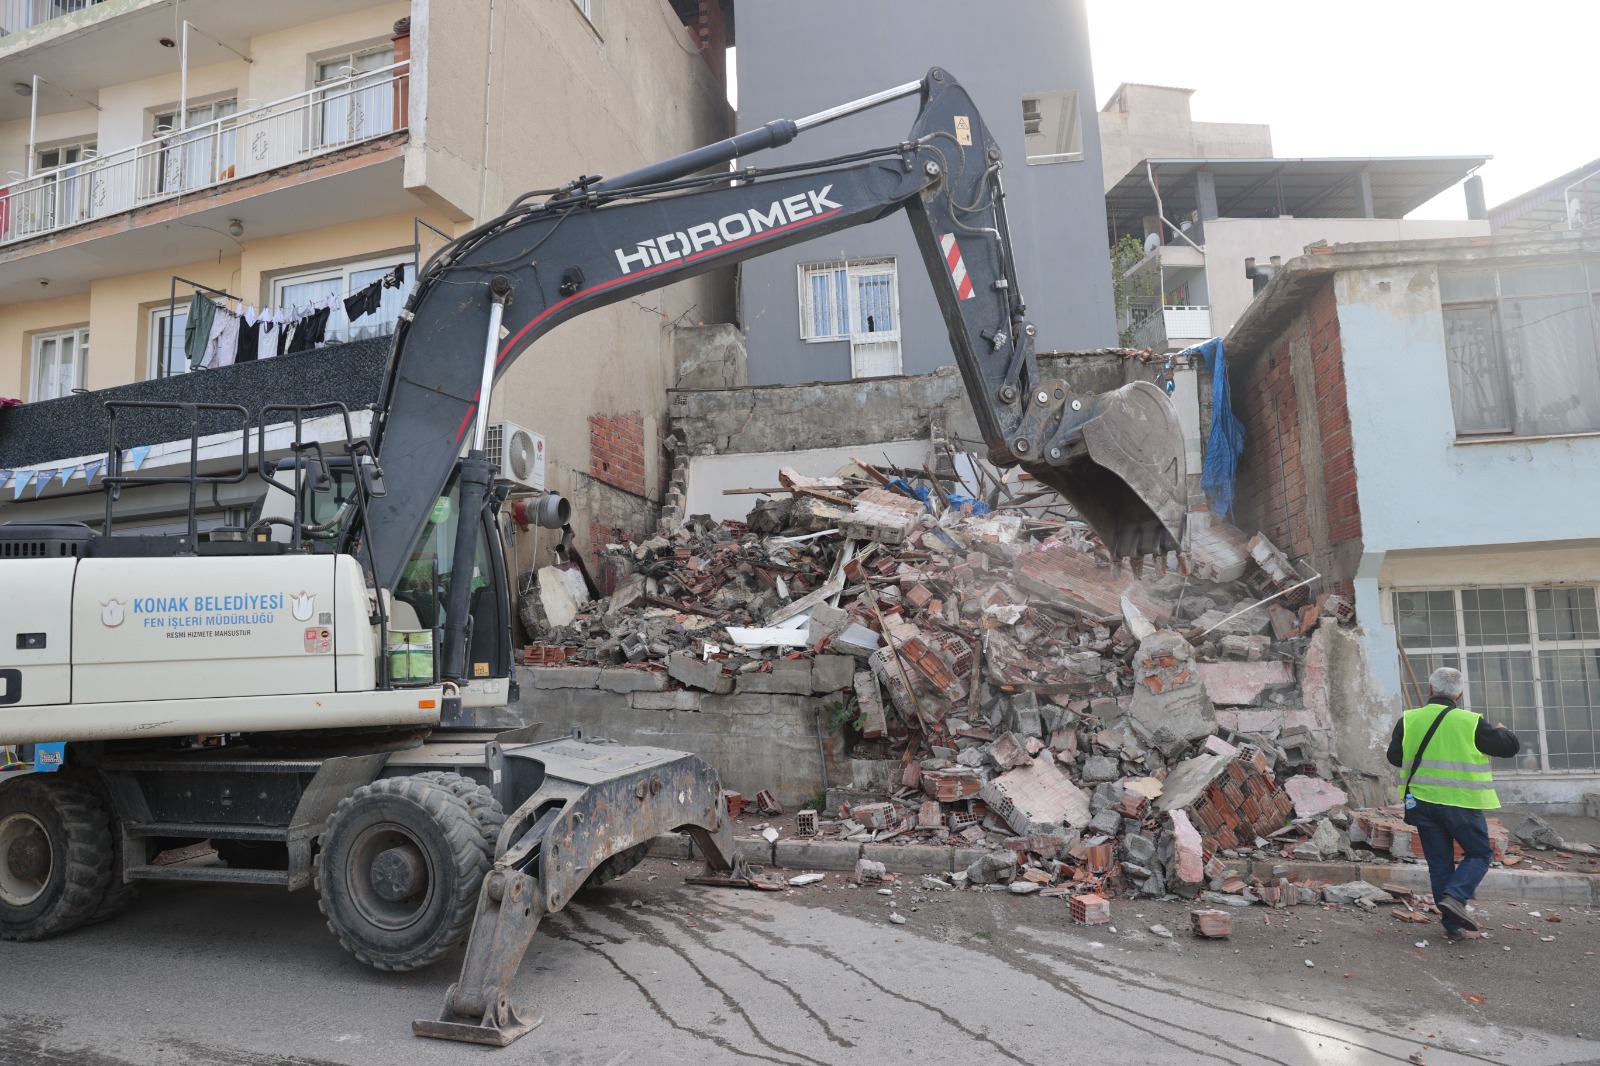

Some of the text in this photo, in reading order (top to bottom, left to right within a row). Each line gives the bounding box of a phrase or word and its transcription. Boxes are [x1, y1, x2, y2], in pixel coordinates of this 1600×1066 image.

[133, 592, 284, 613] KONAK BELEDİYESİ
[144, 612, 274, 630] FEN İŞLERİ MÜDÜRLÜĞÜ
[214, 629, 251, 637] MAHSUSTUR
